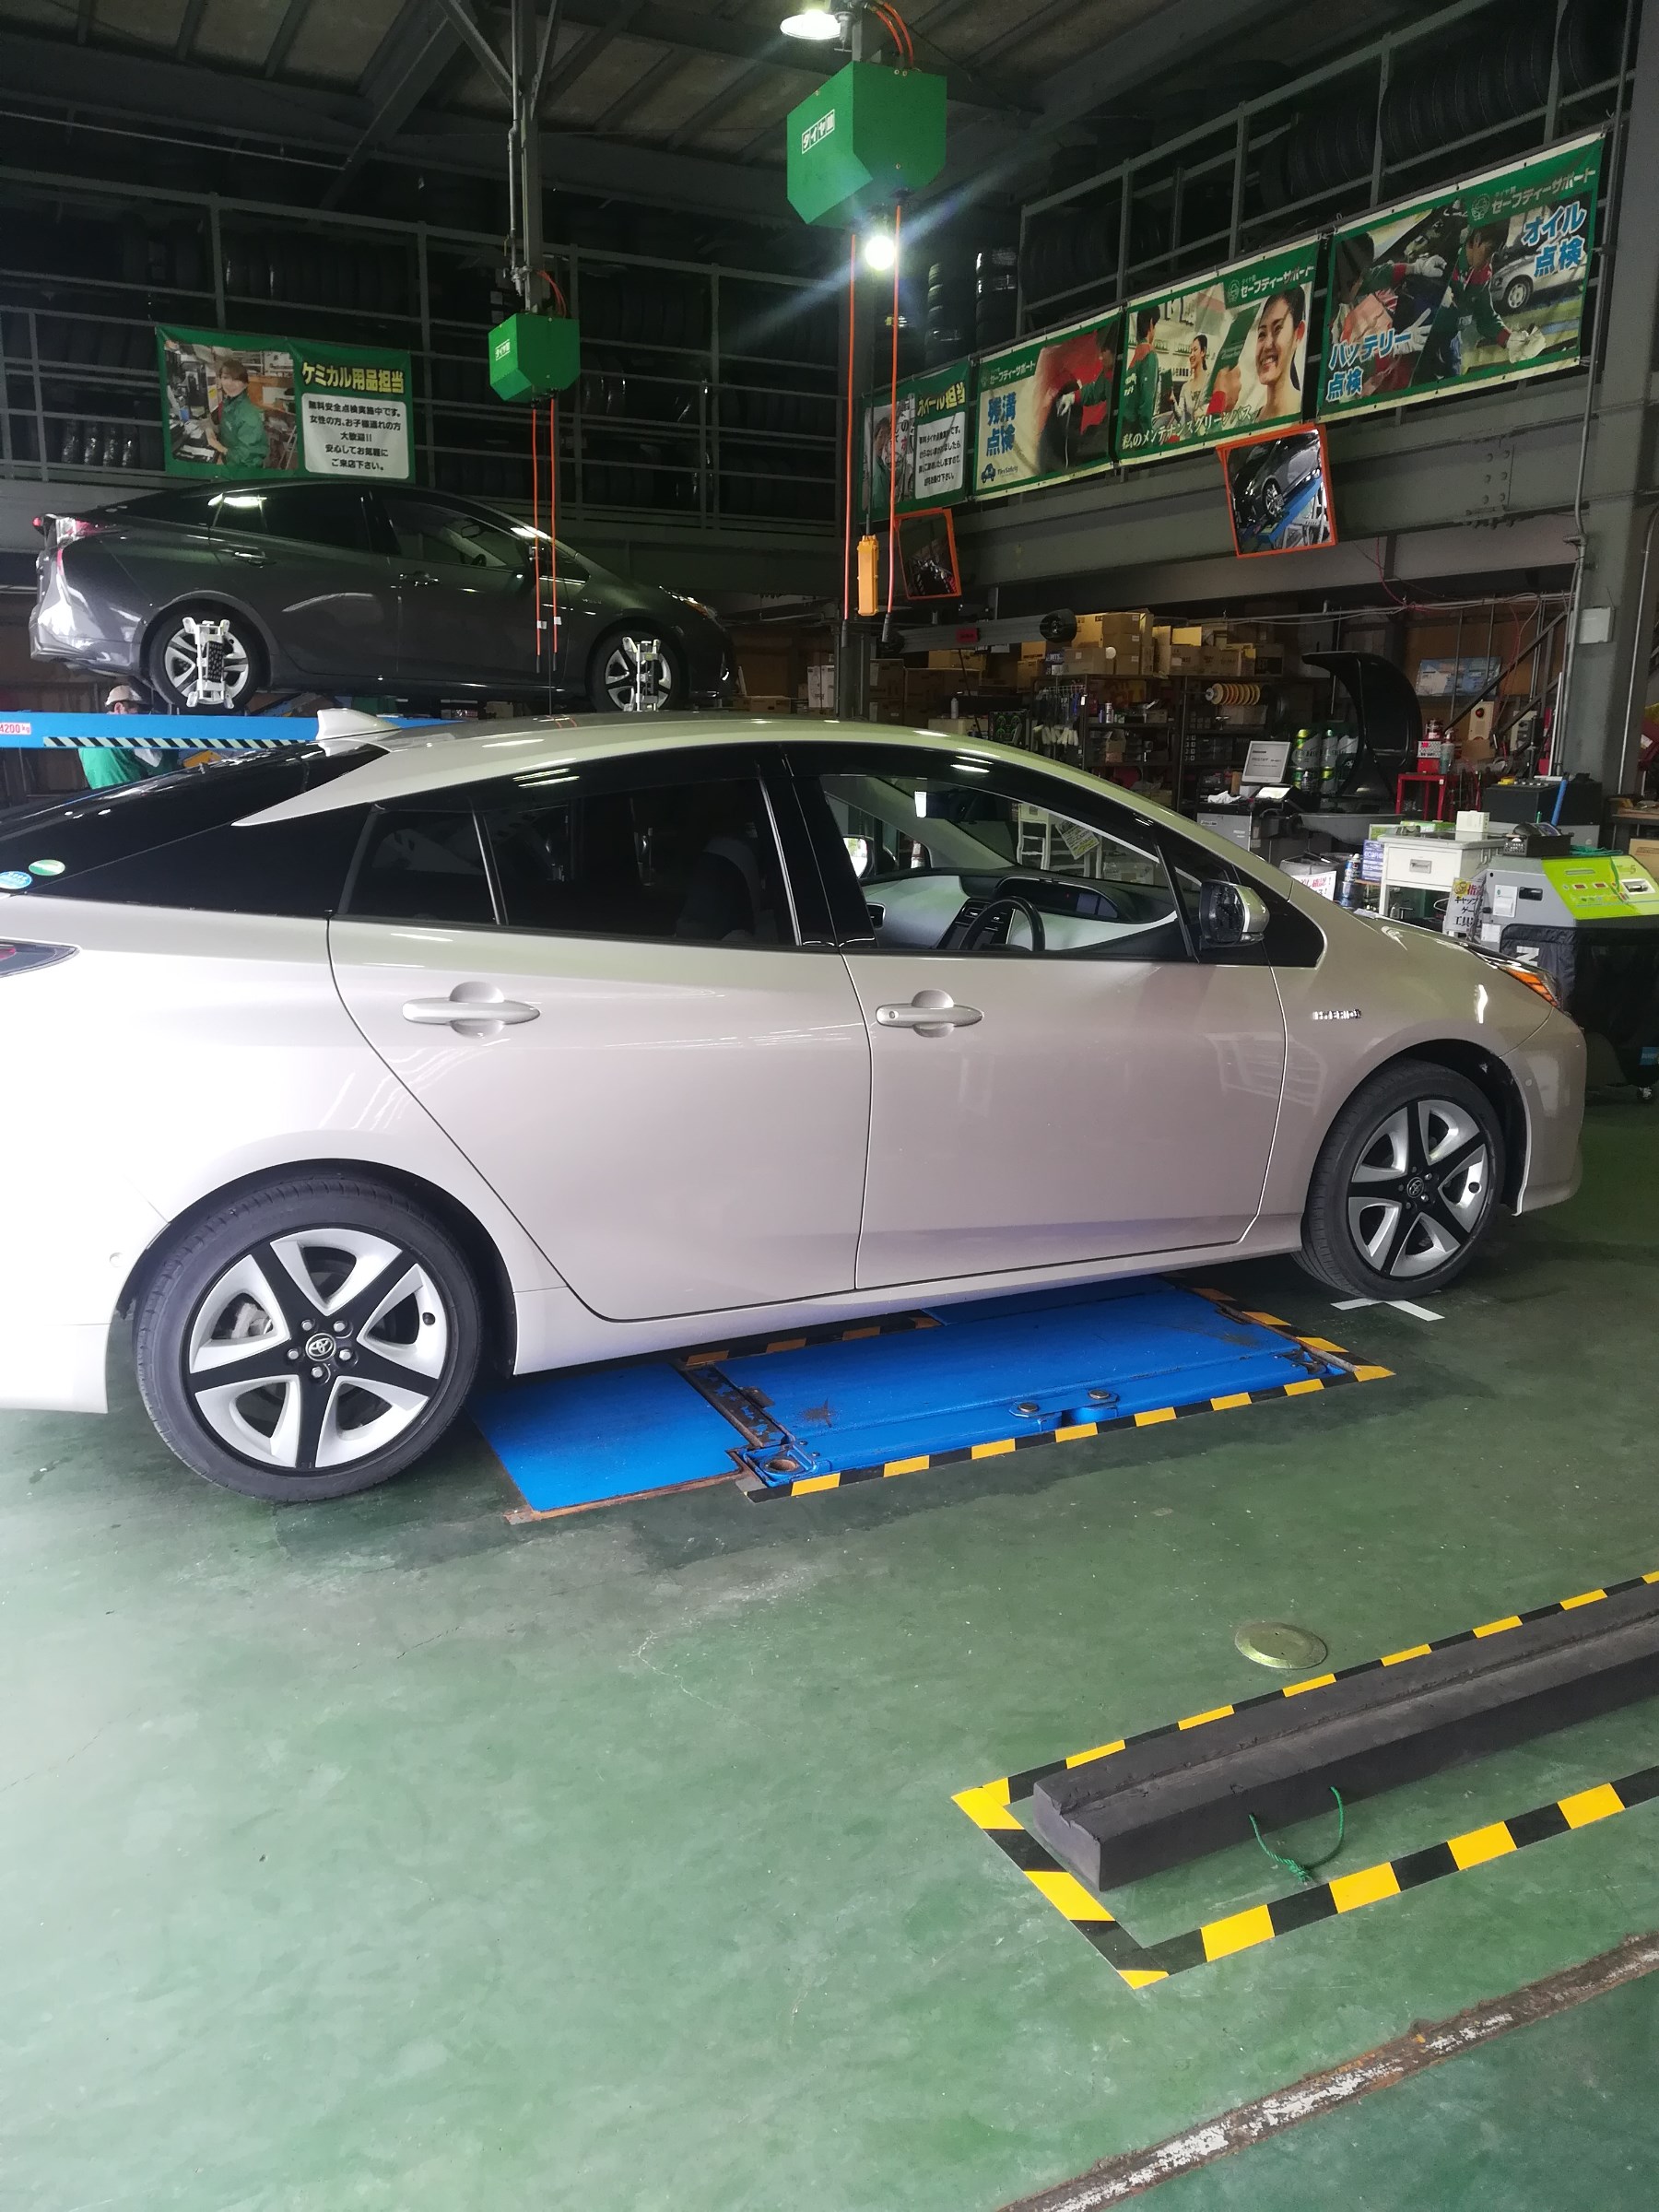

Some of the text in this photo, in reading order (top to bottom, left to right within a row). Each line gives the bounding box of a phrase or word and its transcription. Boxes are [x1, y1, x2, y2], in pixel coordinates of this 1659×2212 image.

[1491, 167, 1596, 215] セーフティーサポート
[1522, 200, 1587, 246] オイル
[1534, 234, 1585, 277] 点検
[1241, 265, 1314, 299] セーフティーサポート
[1329, 328, 1413, 370] バッテリー
[301, 361, 405, 394] ケミカル用品担当
[1326, 366, 1364, 402] 点検
[917, 382, 966, 418] ホイール担当
[324, 443, 389, 457] 安心してお気軽に
[986, 423, 1016, 457] 点検
